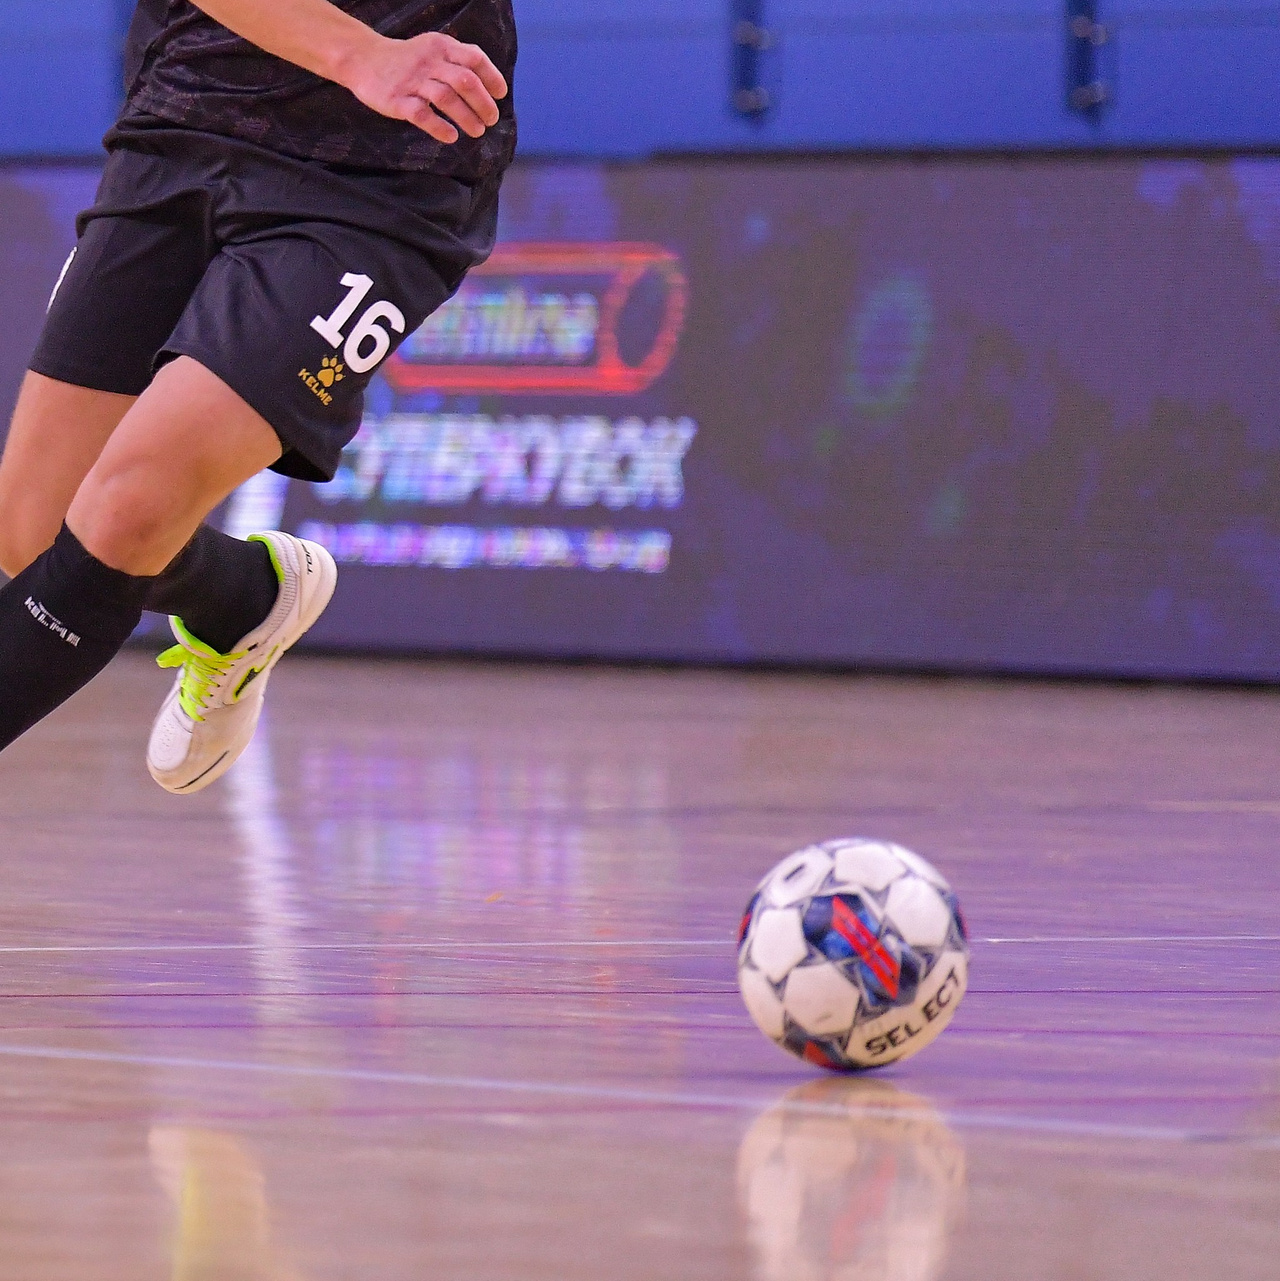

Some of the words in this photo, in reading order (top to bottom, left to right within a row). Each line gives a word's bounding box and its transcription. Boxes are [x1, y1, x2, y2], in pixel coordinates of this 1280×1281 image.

[309, 272, 406, 374] 16
[297, 368, 333, 406] KELME
[865, 967, 959, 1056] SELECT
